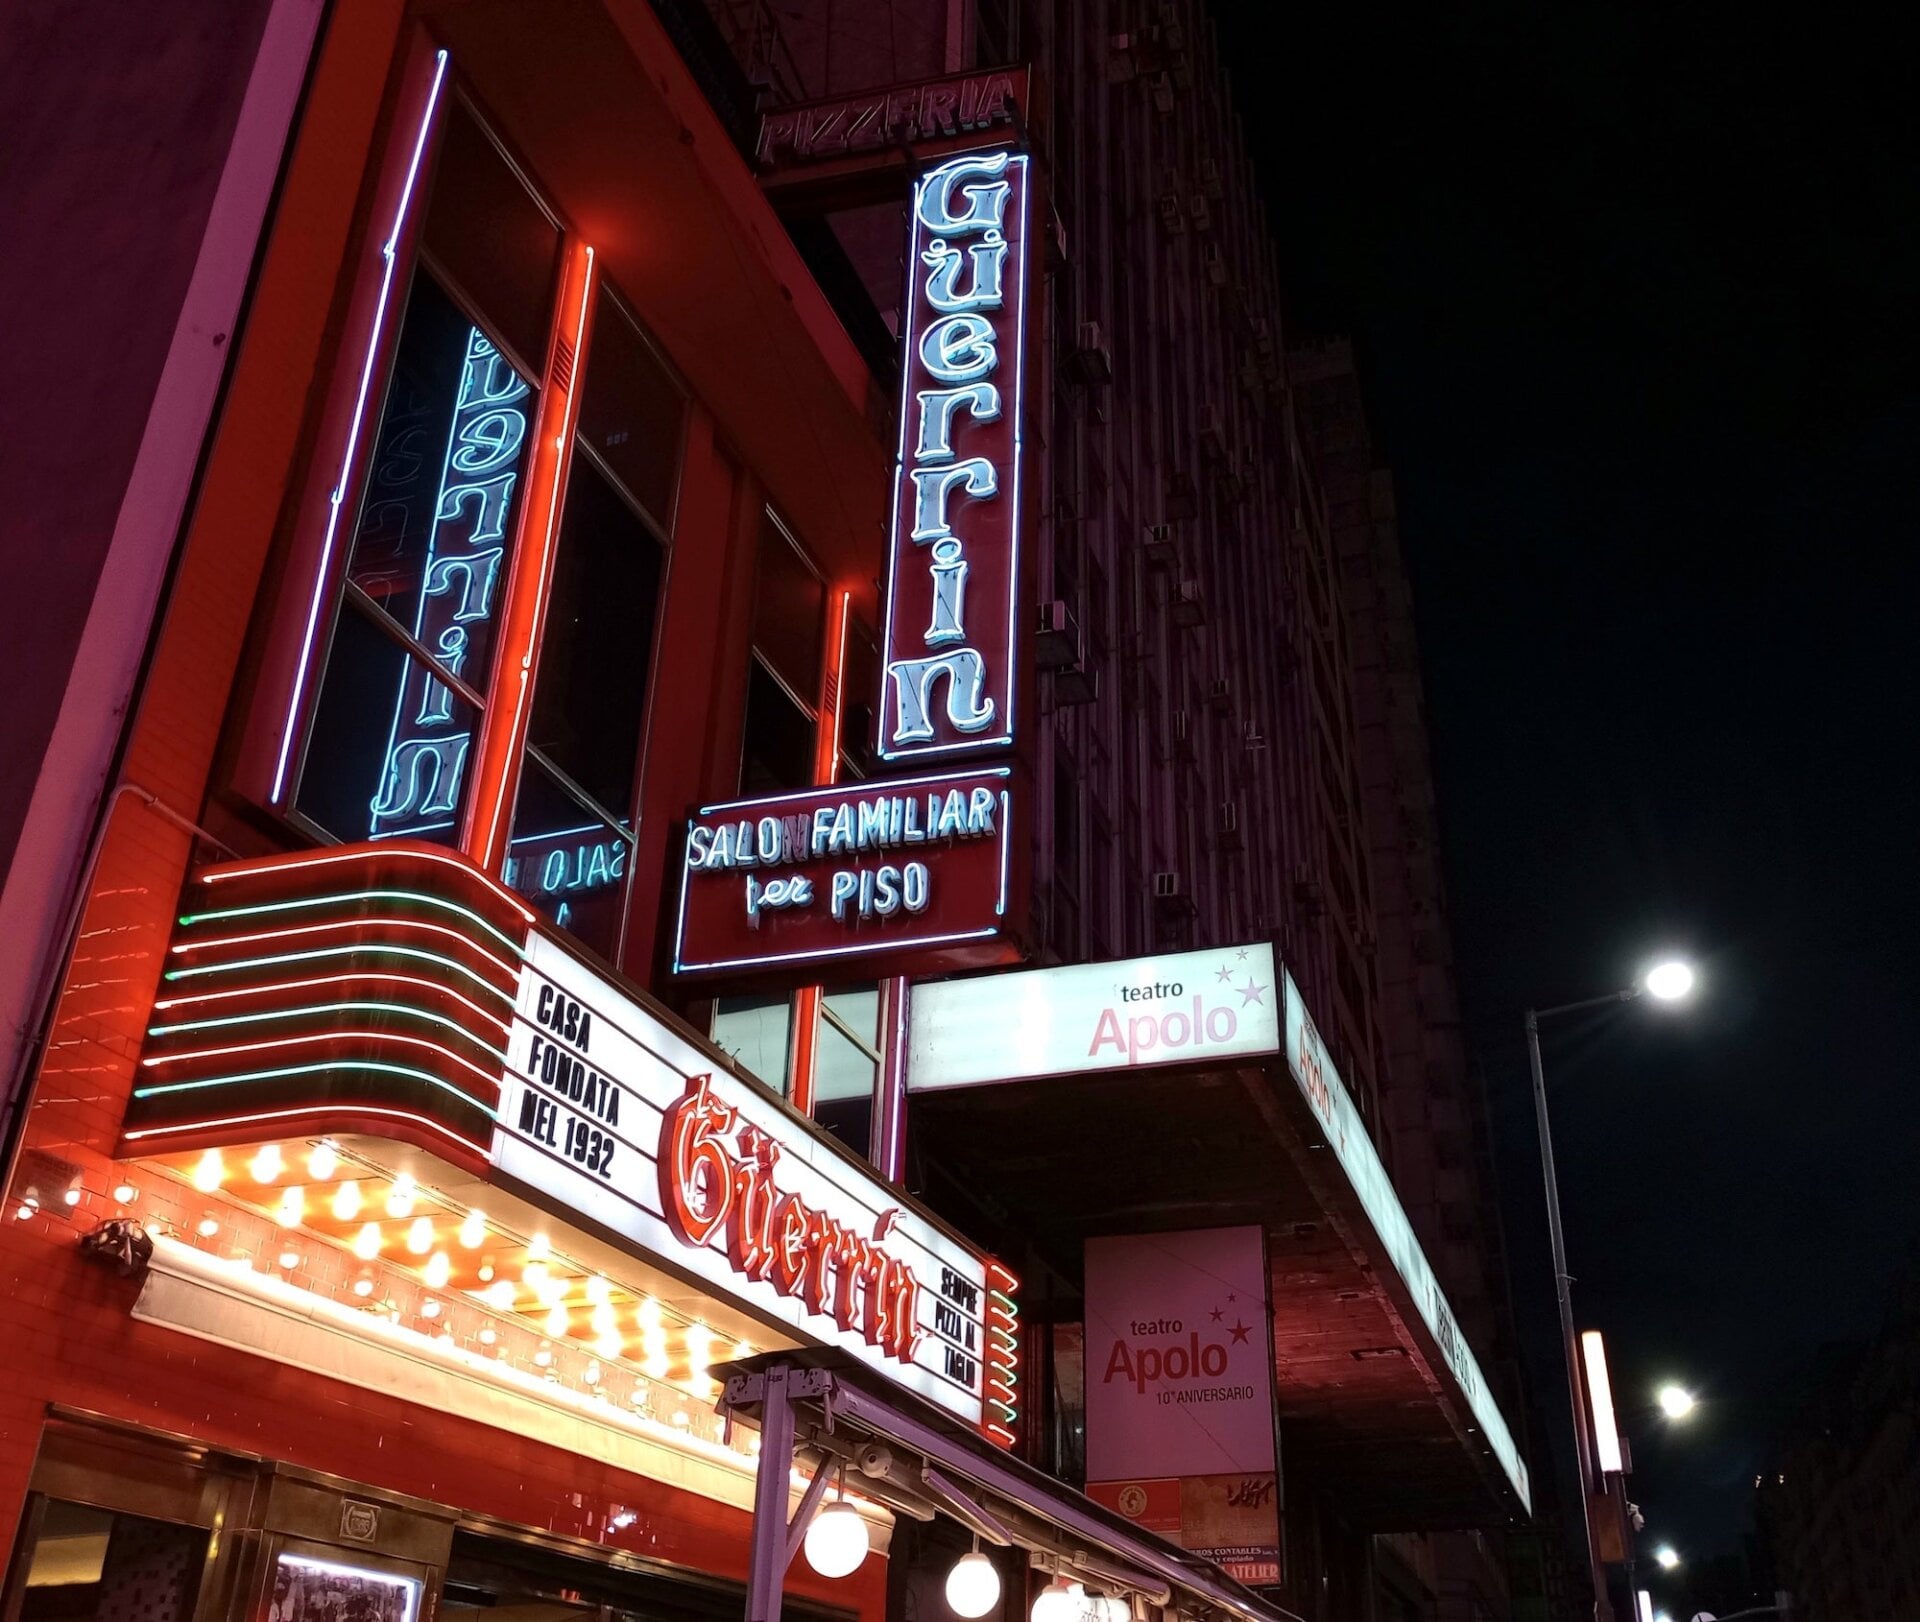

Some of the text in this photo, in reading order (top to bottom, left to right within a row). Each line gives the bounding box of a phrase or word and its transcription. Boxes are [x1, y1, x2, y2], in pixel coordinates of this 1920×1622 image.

[755, 74, 1015, 164] PIZZERIA
[888, 152, 1012, 745] Güerrin
[811, 787, 998, 856] FAMILIAR
[830, 862, 930, 921] PISO
[536, 983, 592, 1054] CASA
[1120, 981, 1184, 1003] teatro
[1088, 995, 1238, 1065] Apolo
[527, 1034, 621, 1128] FONDATA
[518, 1089, 615, 1180] NEL 1932
[935, 1300, 962, 1343] PIZZA
[941, 1266, 979, 1316] SEMPRE
[1130, 1317, 1183, 1336] teatro
[1103, 1333, 1228, 1394] Apolo
[1177, 1385, 1254, 1404] ANIVERSARIO
